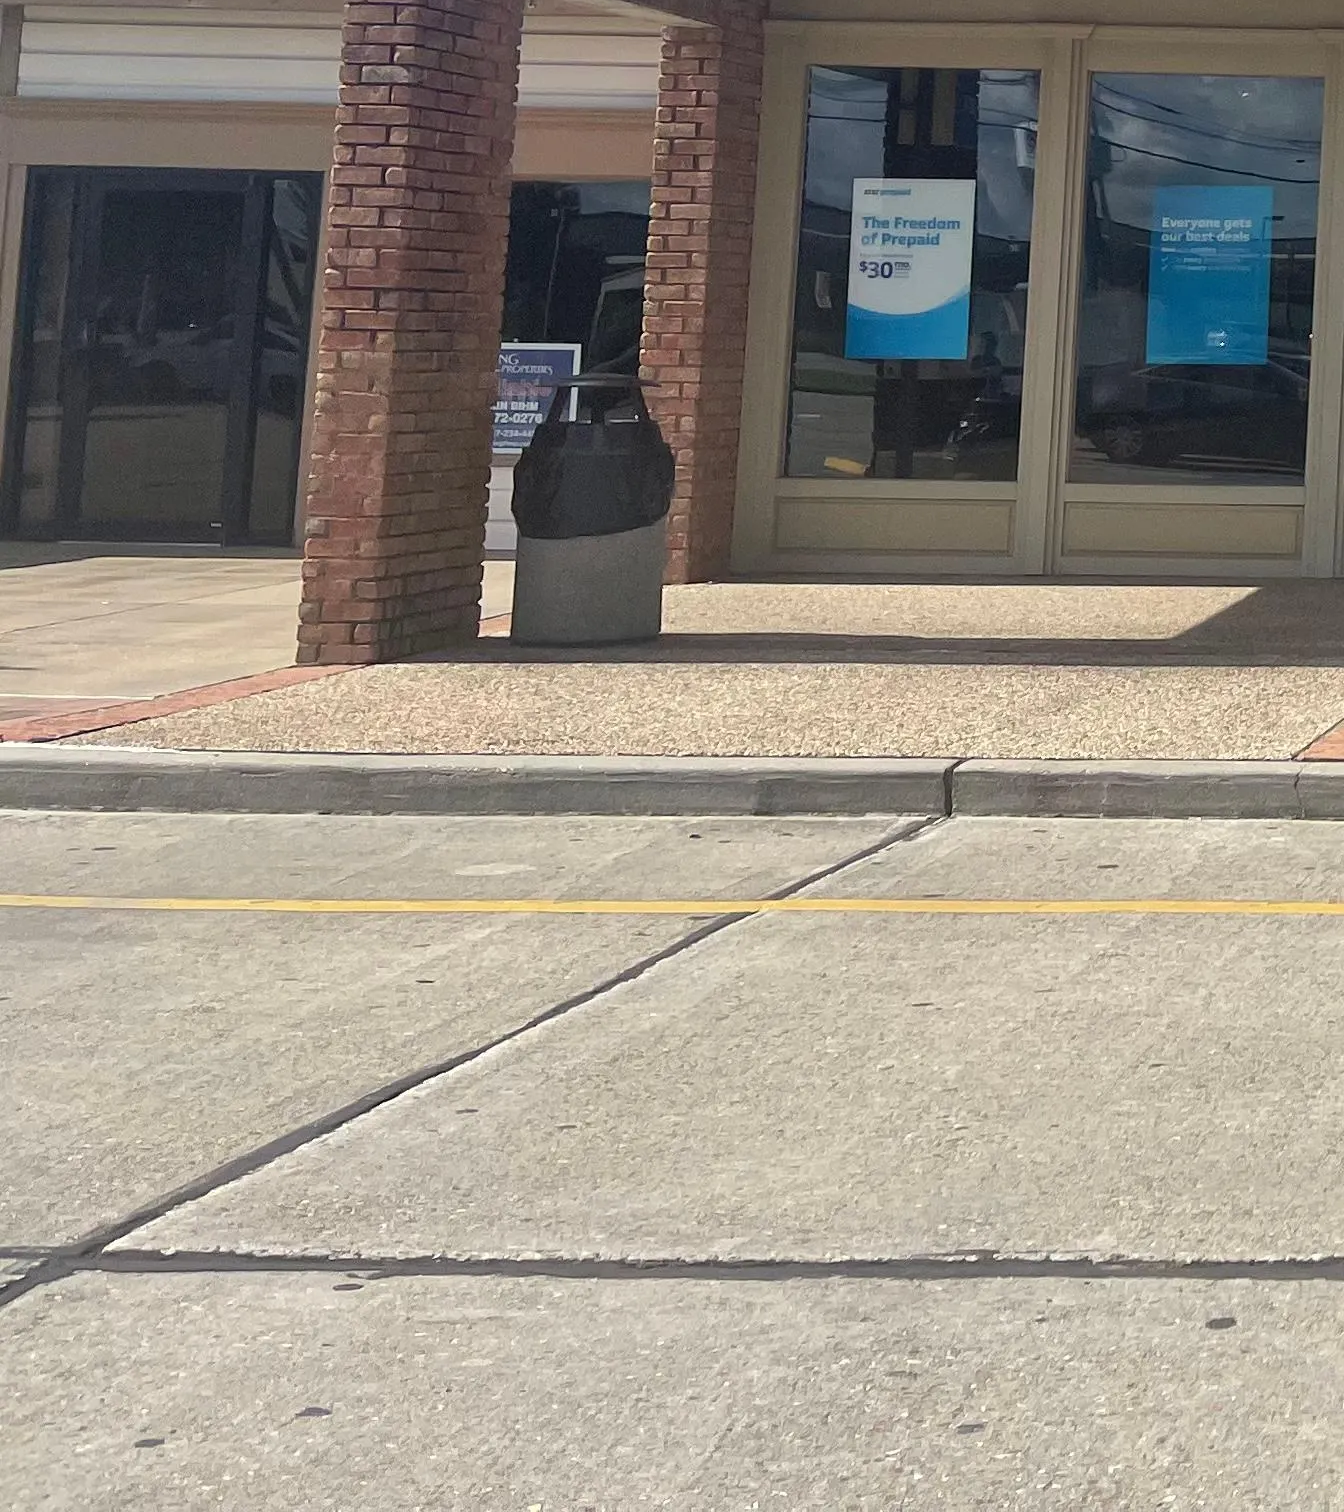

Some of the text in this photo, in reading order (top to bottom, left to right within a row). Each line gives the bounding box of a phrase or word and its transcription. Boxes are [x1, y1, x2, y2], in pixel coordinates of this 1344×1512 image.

[862, 216, 960, 230] The Freedom
[1162, 217, 1253, 231] Everyone gets
[861, 232, 940, 248] of Prepaid
[1217, 230, 1250, 242] deals
[859, 261, 893, 279] $30
